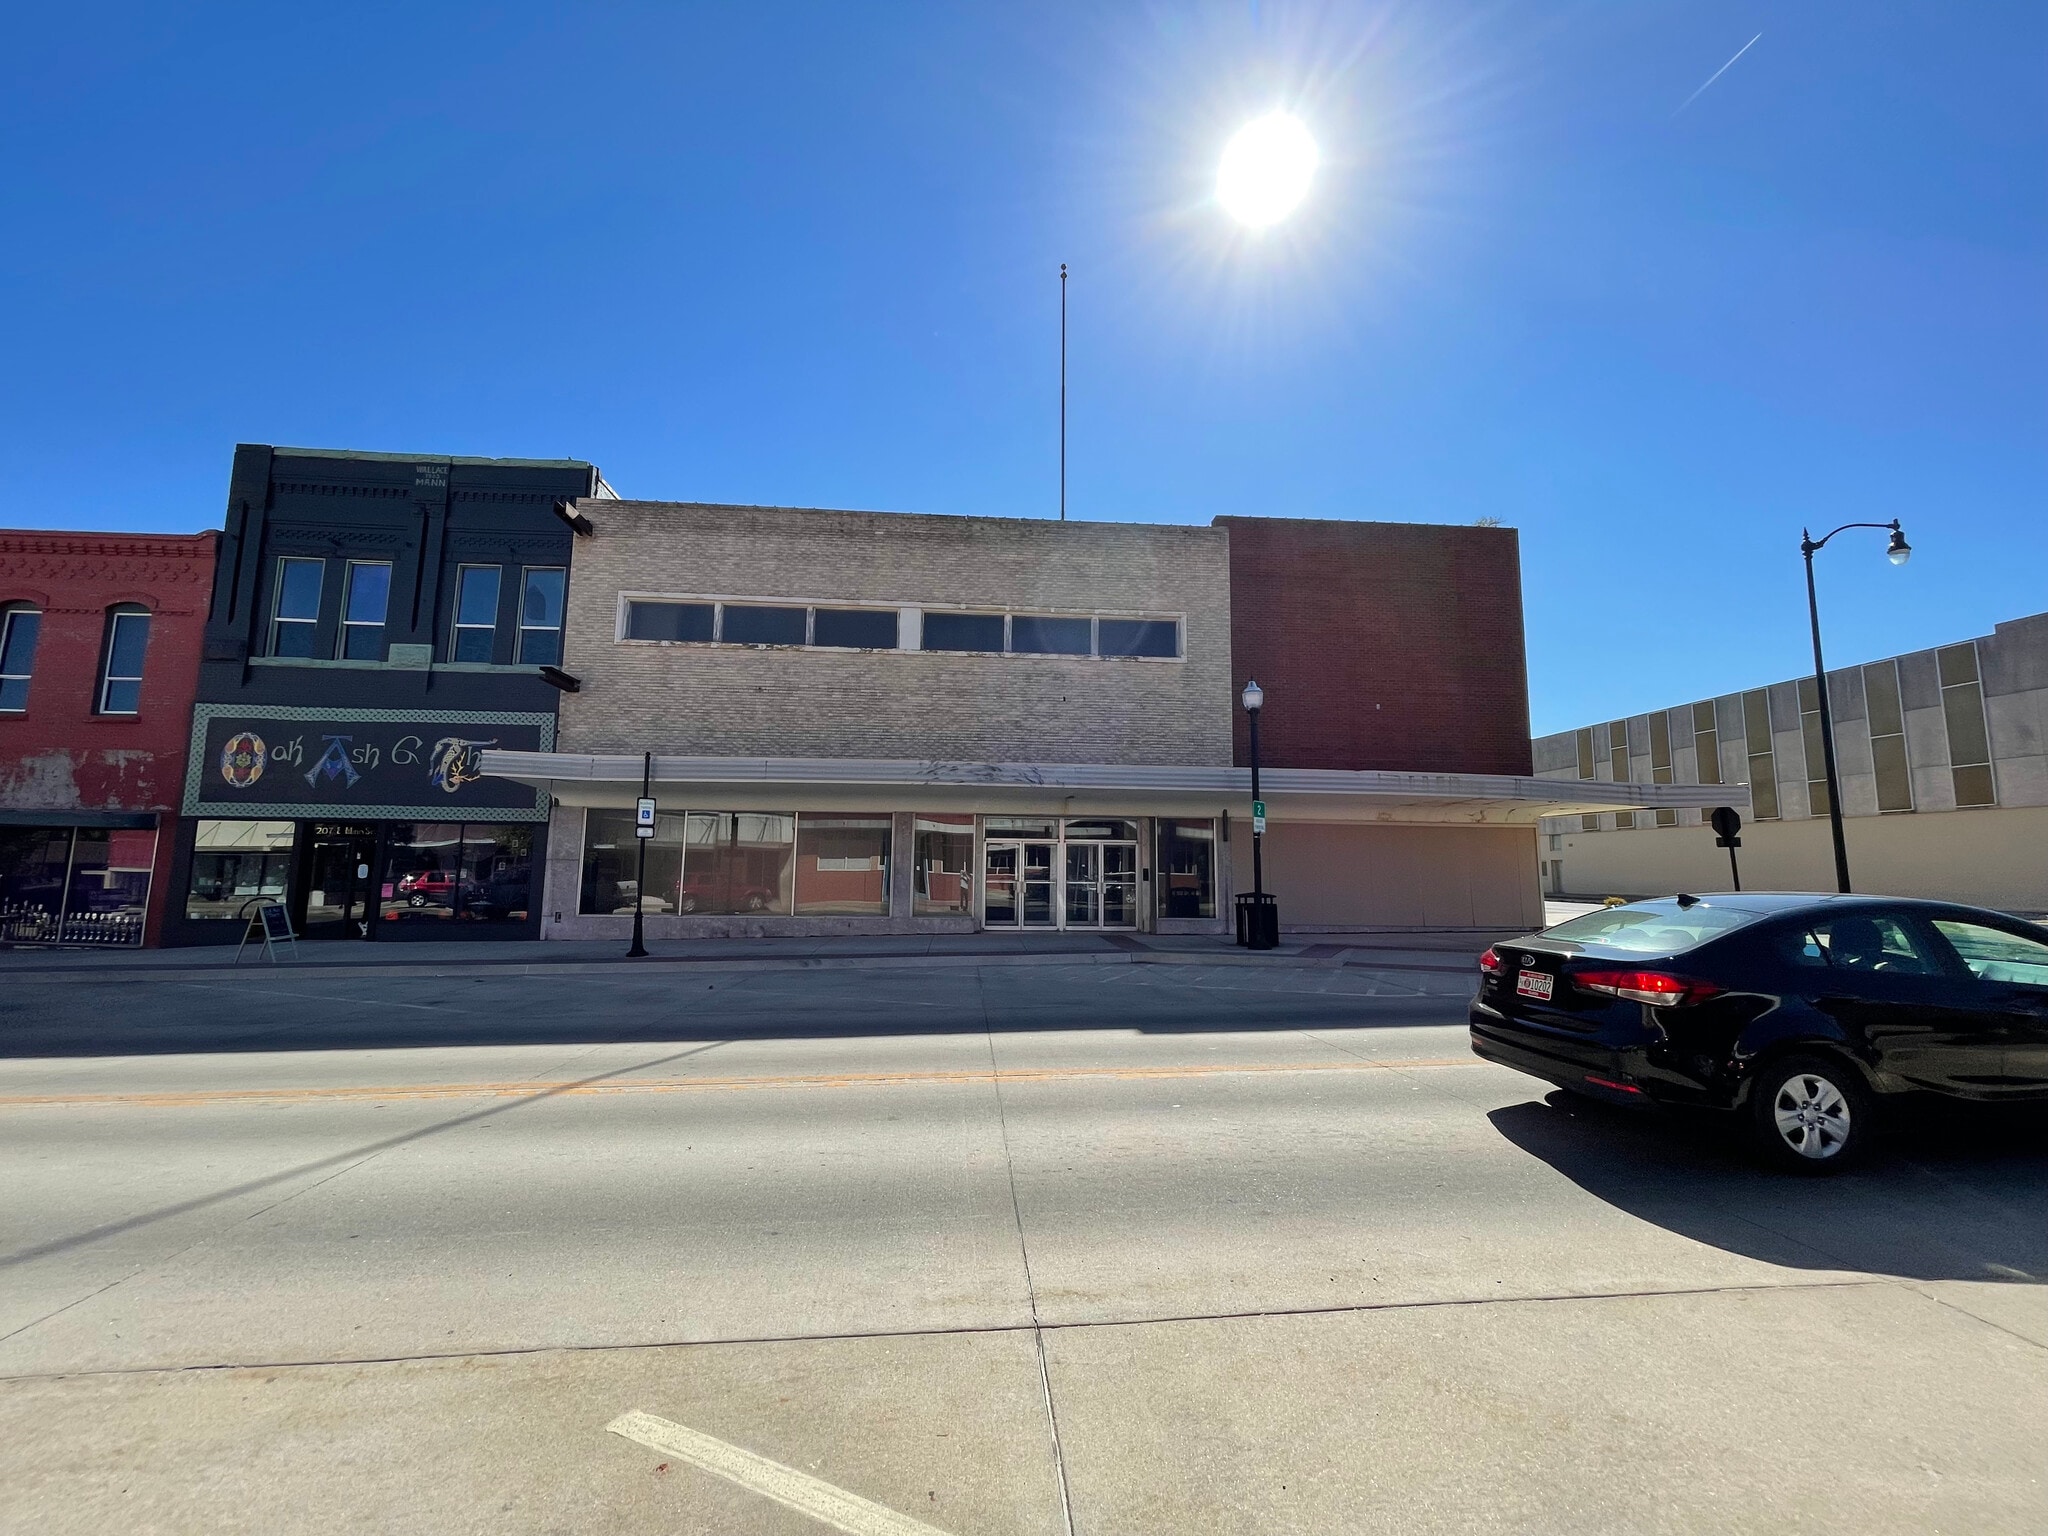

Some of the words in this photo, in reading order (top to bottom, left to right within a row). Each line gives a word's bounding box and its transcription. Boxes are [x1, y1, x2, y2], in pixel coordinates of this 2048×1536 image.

[416, 465, 449, 475] WALLACE
[415, 478, 446, 487] MANN
[220, 732, 304, 788] Oak
[304, 735, 379, 789] Ash
[428, 737, 498, 793] Th
[1257, 804, 1262, 816] 2
